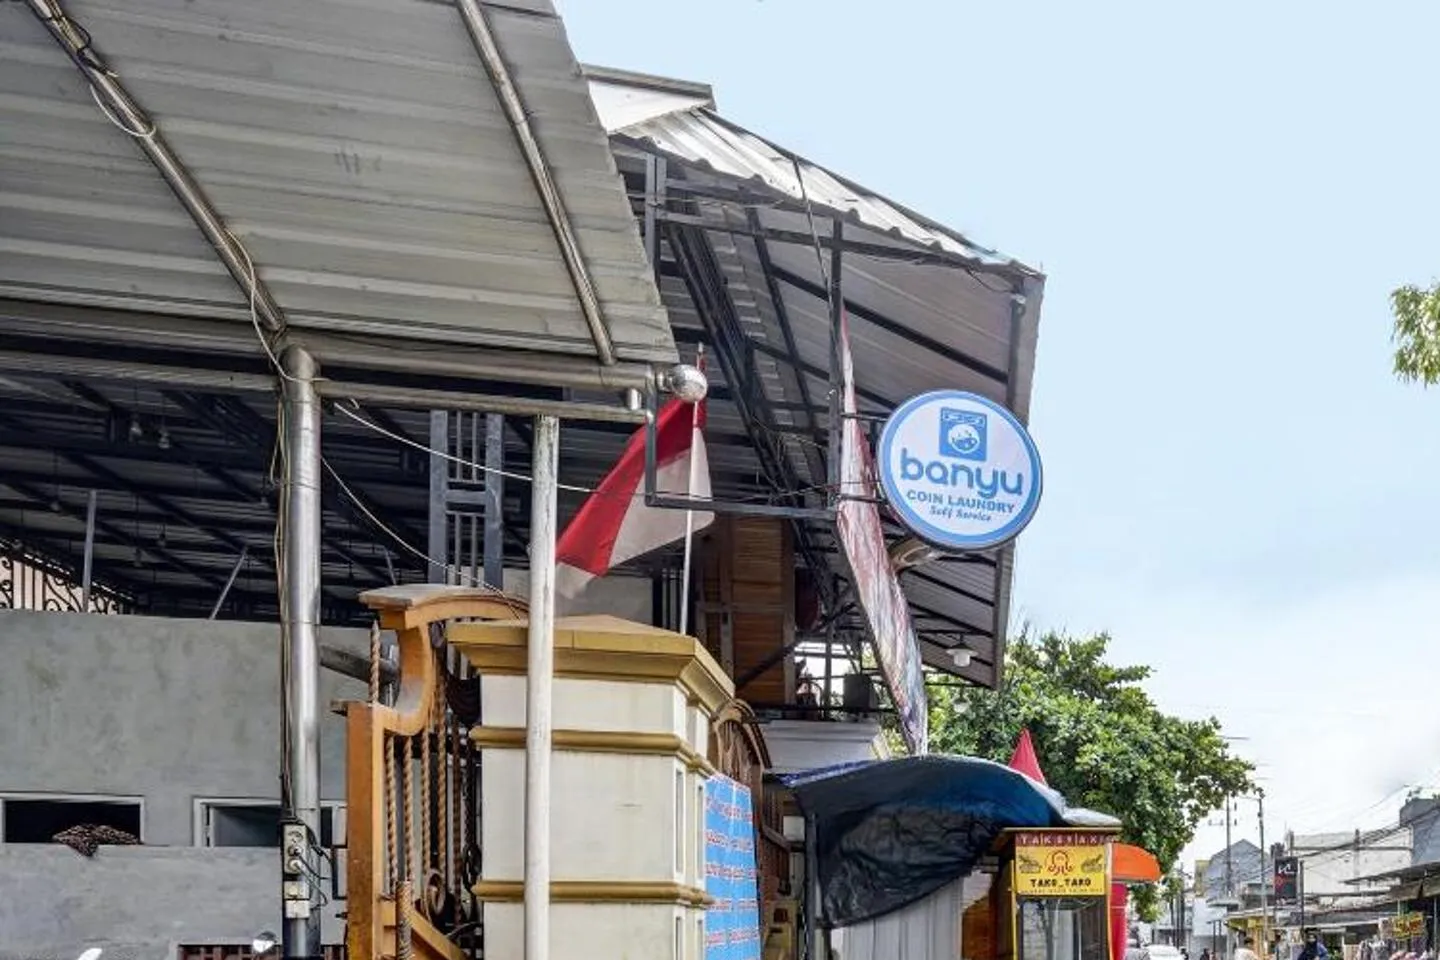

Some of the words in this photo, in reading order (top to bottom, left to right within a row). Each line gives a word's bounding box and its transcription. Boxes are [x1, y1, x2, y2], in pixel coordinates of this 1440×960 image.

[901, 448, 1023, 499] banyu
[907, 489, 944, 505] COIN
[949, 495, 1016, 514] LAUNDRY
[929, 505, 953, 519] Self
[956, 508, 992, 522] Service
